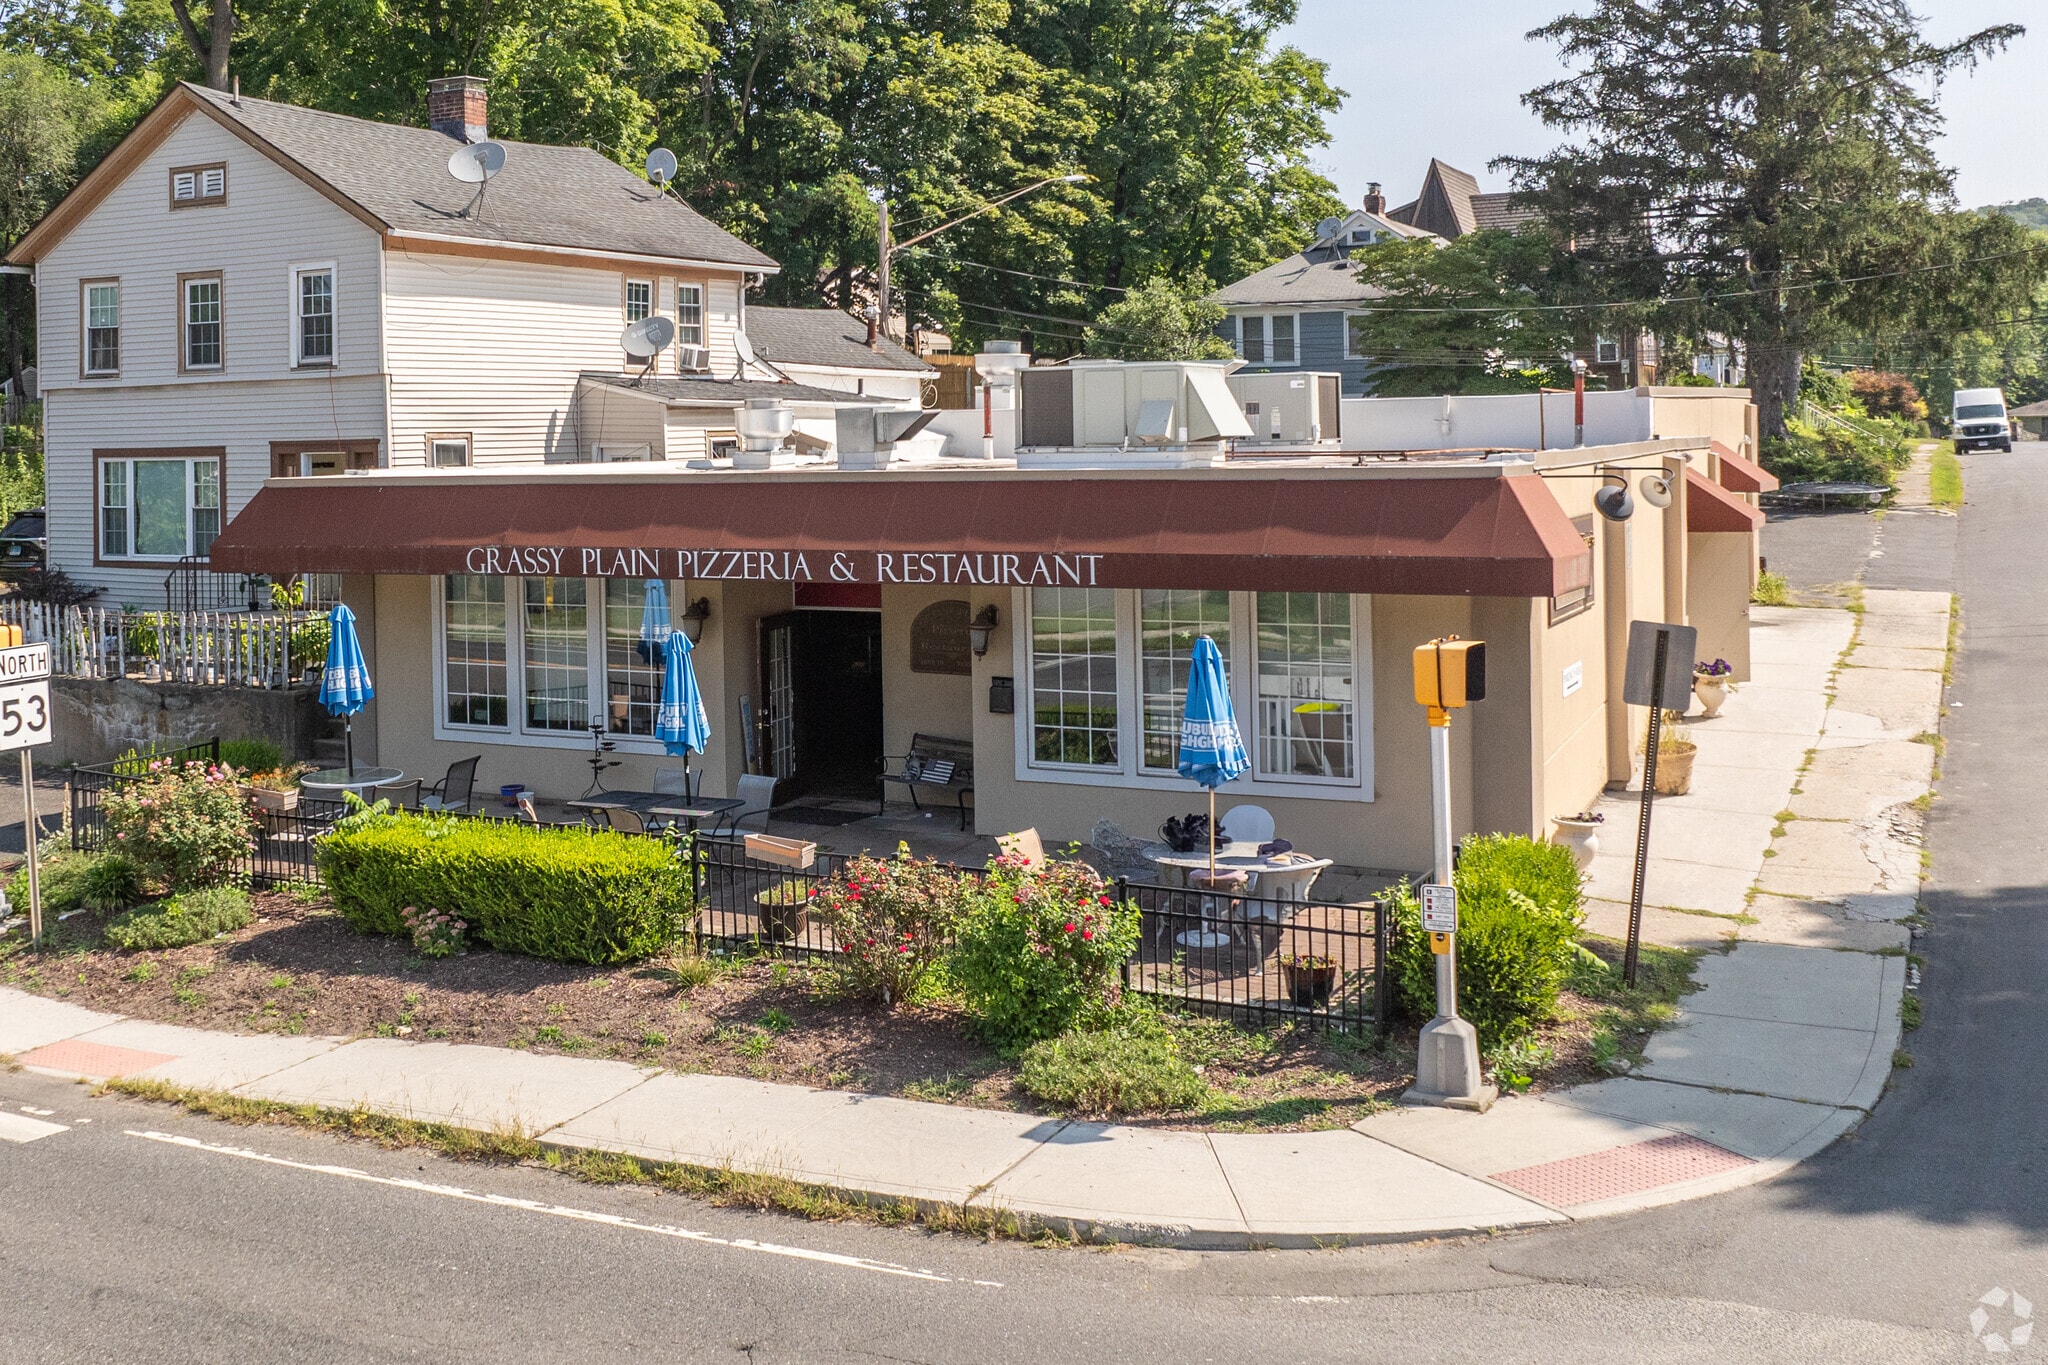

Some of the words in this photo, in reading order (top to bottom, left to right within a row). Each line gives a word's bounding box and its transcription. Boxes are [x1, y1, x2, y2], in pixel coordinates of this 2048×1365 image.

[466, 547, 564, 575] GRASSY
[581, 548, 660, 576] PLAIN
[677, 550, 812, 581] PIZZERIA
[829, 552, 859, 582] &
[876, 553, 1103, 586] RESTAURANT
[0, 652, 47, 676] NORTH
[2, 694, 47, 737] 53
